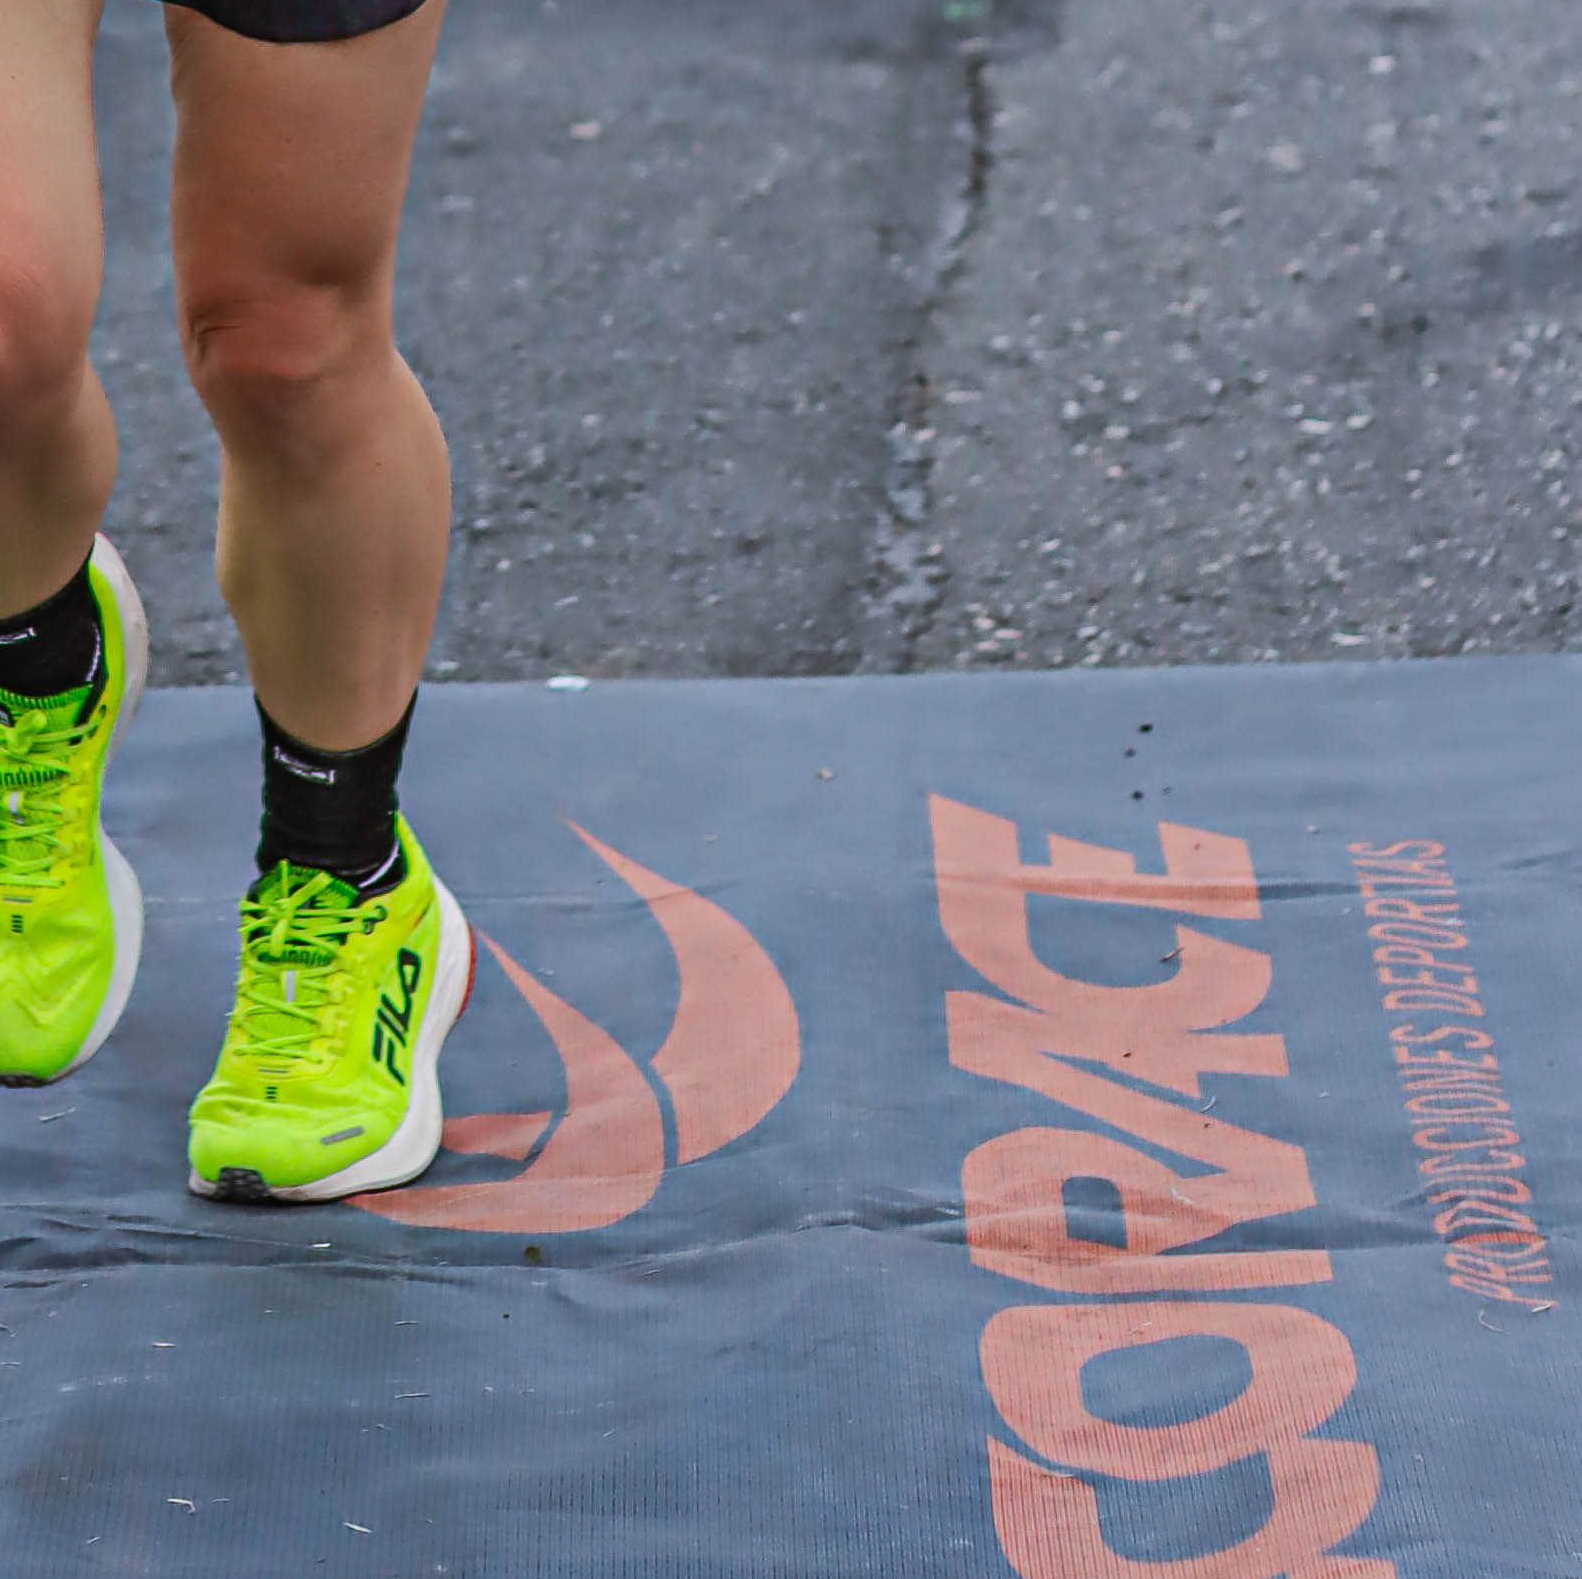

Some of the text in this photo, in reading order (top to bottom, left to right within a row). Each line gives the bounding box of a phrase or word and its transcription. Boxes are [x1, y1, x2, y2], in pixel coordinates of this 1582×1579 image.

[372, 946, 422, 1087] FILA
[928, 793, 1398, 1579] CORACE
[1388, 1023, 1558, 1307] PRODUCCIONES
